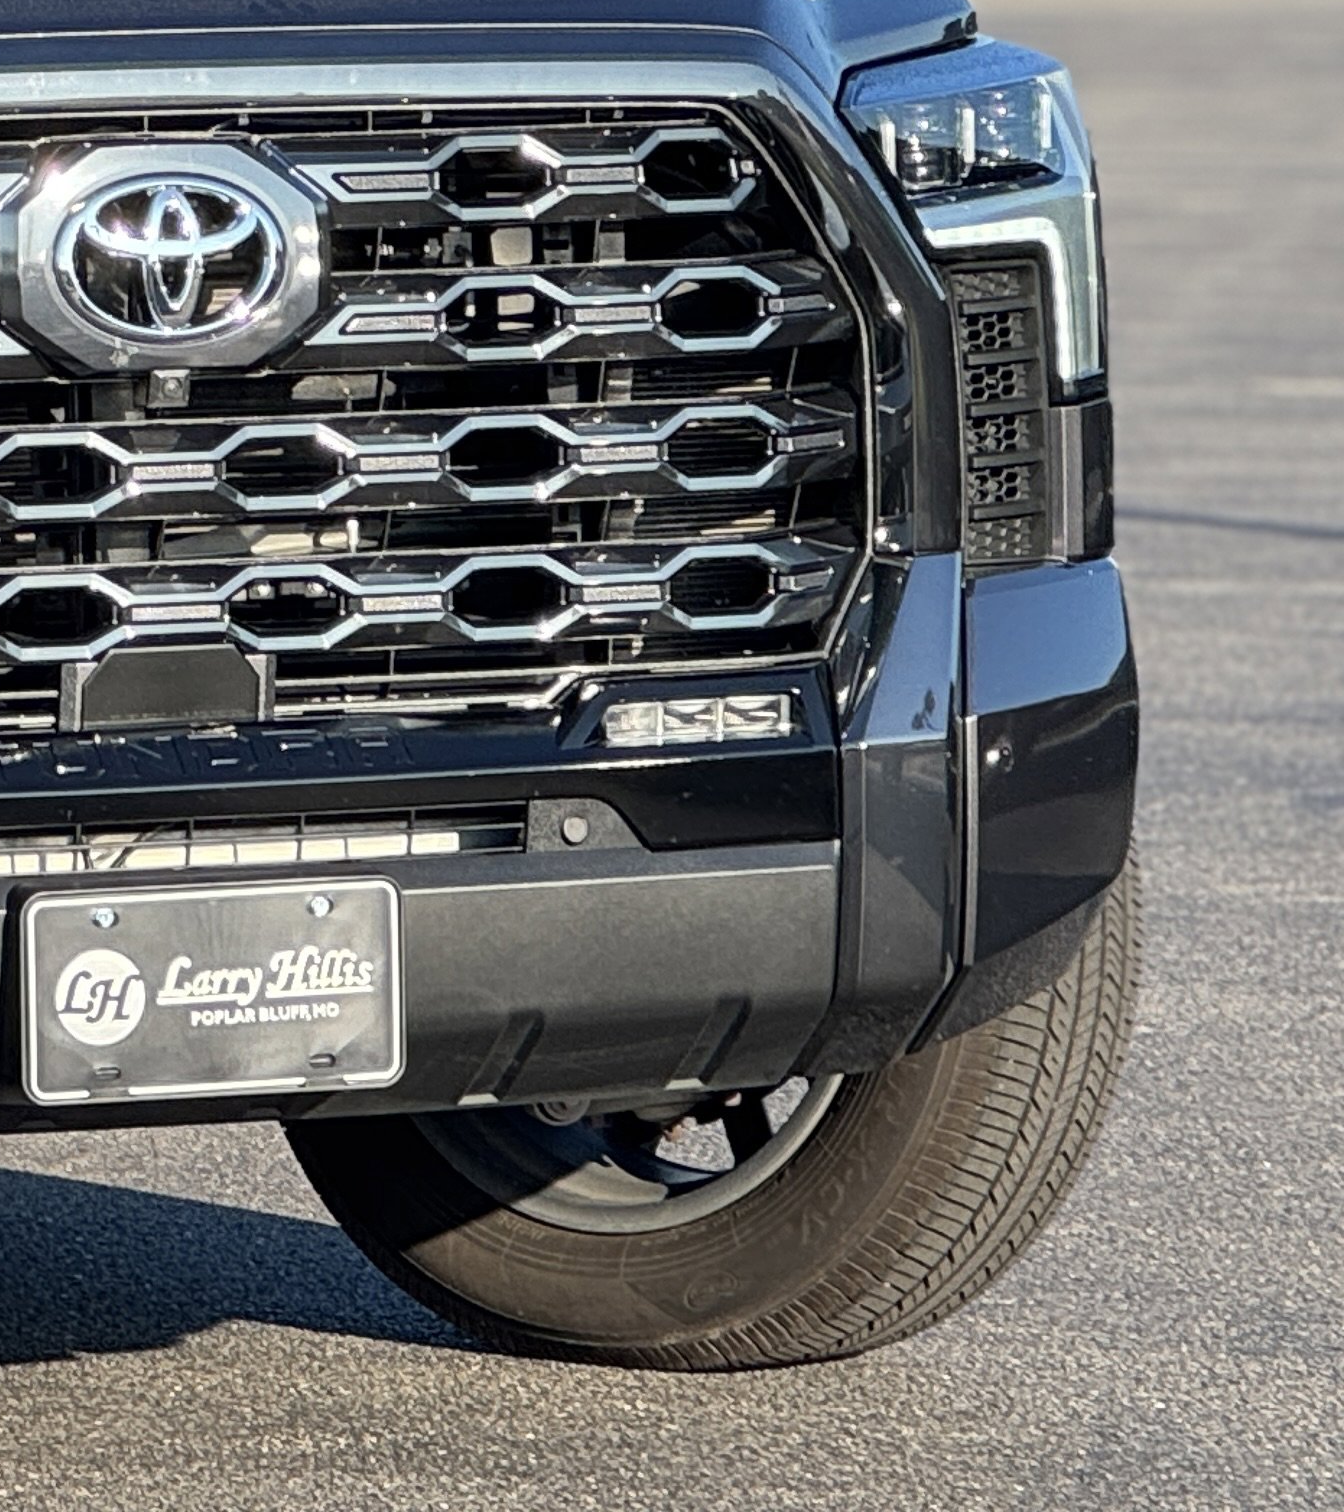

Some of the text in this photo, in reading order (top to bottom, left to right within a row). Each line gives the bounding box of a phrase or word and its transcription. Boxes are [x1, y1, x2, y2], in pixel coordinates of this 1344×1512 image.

[57, 970, 142, 1024] LH
[156, 944, 374, 1006] Larry Hillis
[190, 1006, 257, 1028] POPLAR
